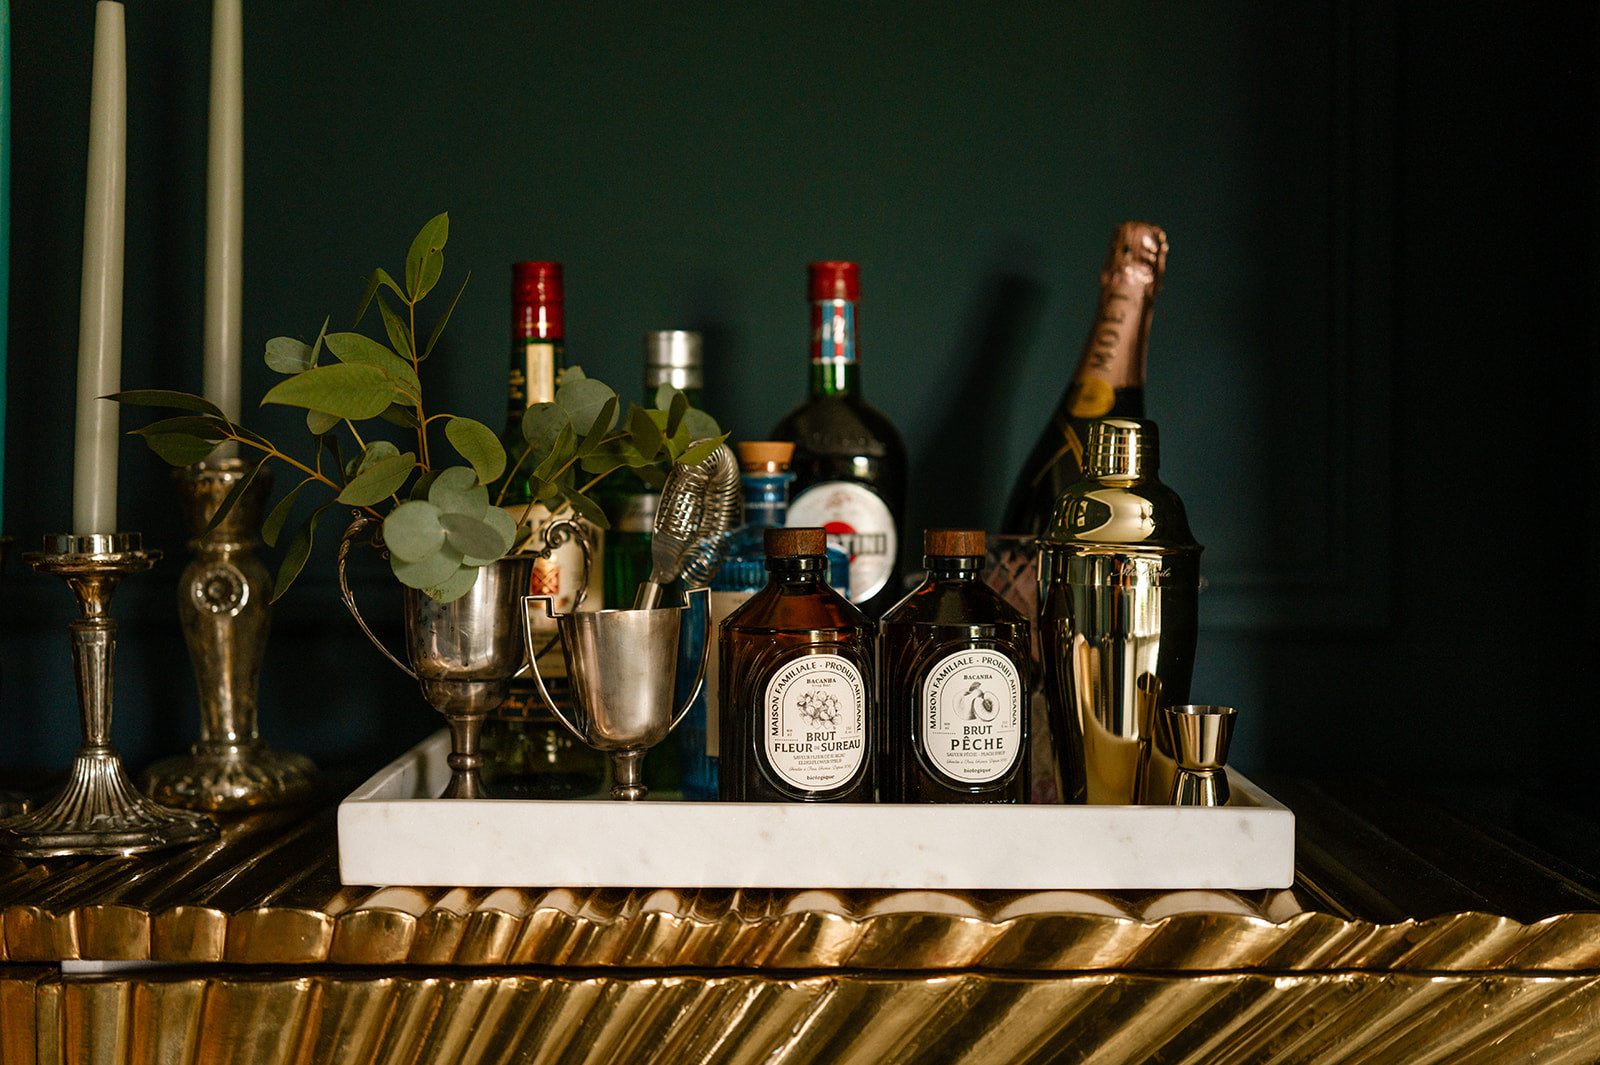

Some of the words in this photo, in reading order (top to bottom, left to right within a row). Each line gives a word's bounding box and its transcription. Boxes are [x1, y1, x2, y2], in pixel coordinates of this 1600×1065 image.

[775, 661, 817, 695] FAMILIALE
[825, 661, 857, 683] PRODUIT
[933, 656, 974, 689] FAMILIALE
[981, 656, 1012, 678] PRODUIT
[771, 695, 780, 737] MAISON
[854, 683, 862, 732] ARTISANAL
[930, 690, 938, 730] MAISON
[1009, 679, 1017, 728] ARTISANAL
[806, 731, 837, 742] BRUT
[951, 736, 1004, 751] PÊCHE
[963, 725, 993, 736] BRUT
[774, 742, 813, 753] FLEUR
[820, 739, 861, 752] SUREAU
